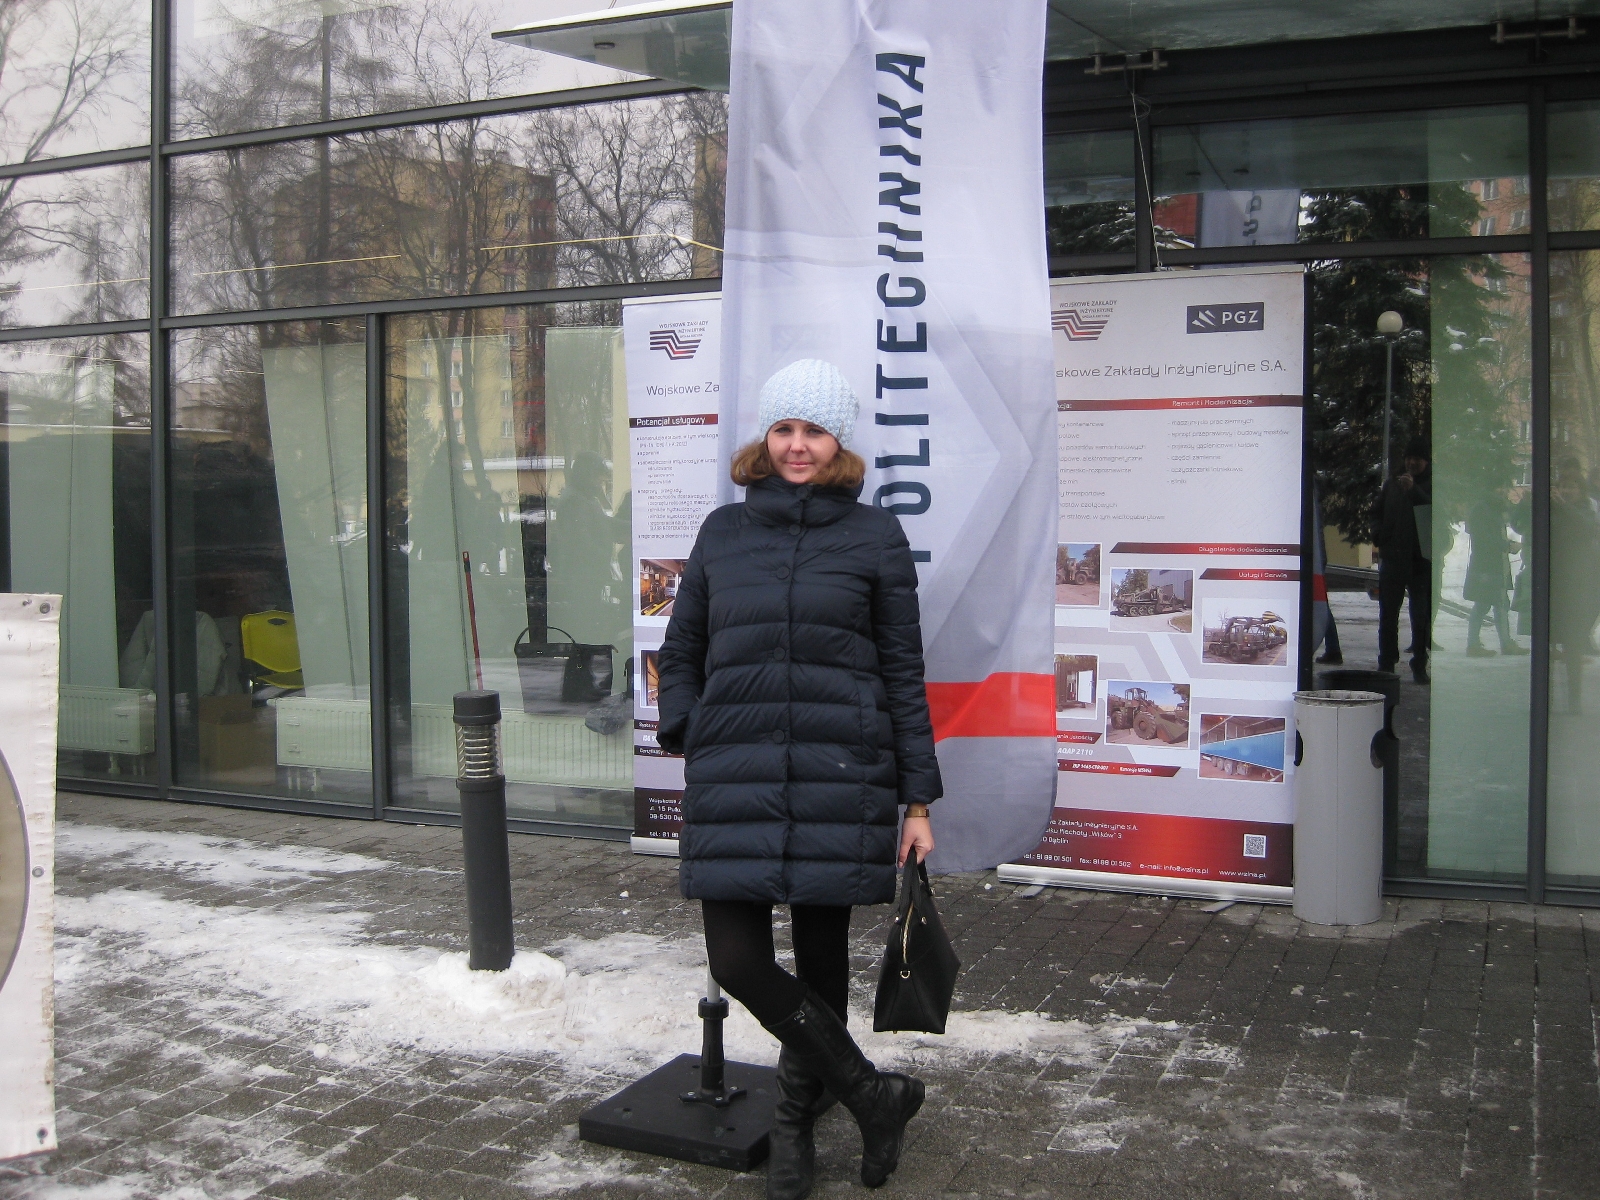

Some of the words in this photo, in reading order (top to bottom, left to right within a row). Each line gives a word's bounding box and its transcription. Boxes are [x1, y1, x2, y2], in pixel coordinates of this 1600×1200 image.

[1222, 310, 1259, 325] PGZ
[1104, 364, 1160, 378] Zakłady
[1164, 361, 1256, 376] Inżynieryjne
[1260, 359, 1288, 372] S.A.
[646, 383, 701, 397] Wojskowe
[636, 417, 670, 427] Potencjał
[672, 416, 706, 426] usługowy
[1076, 748, 1094, 756] 2110
